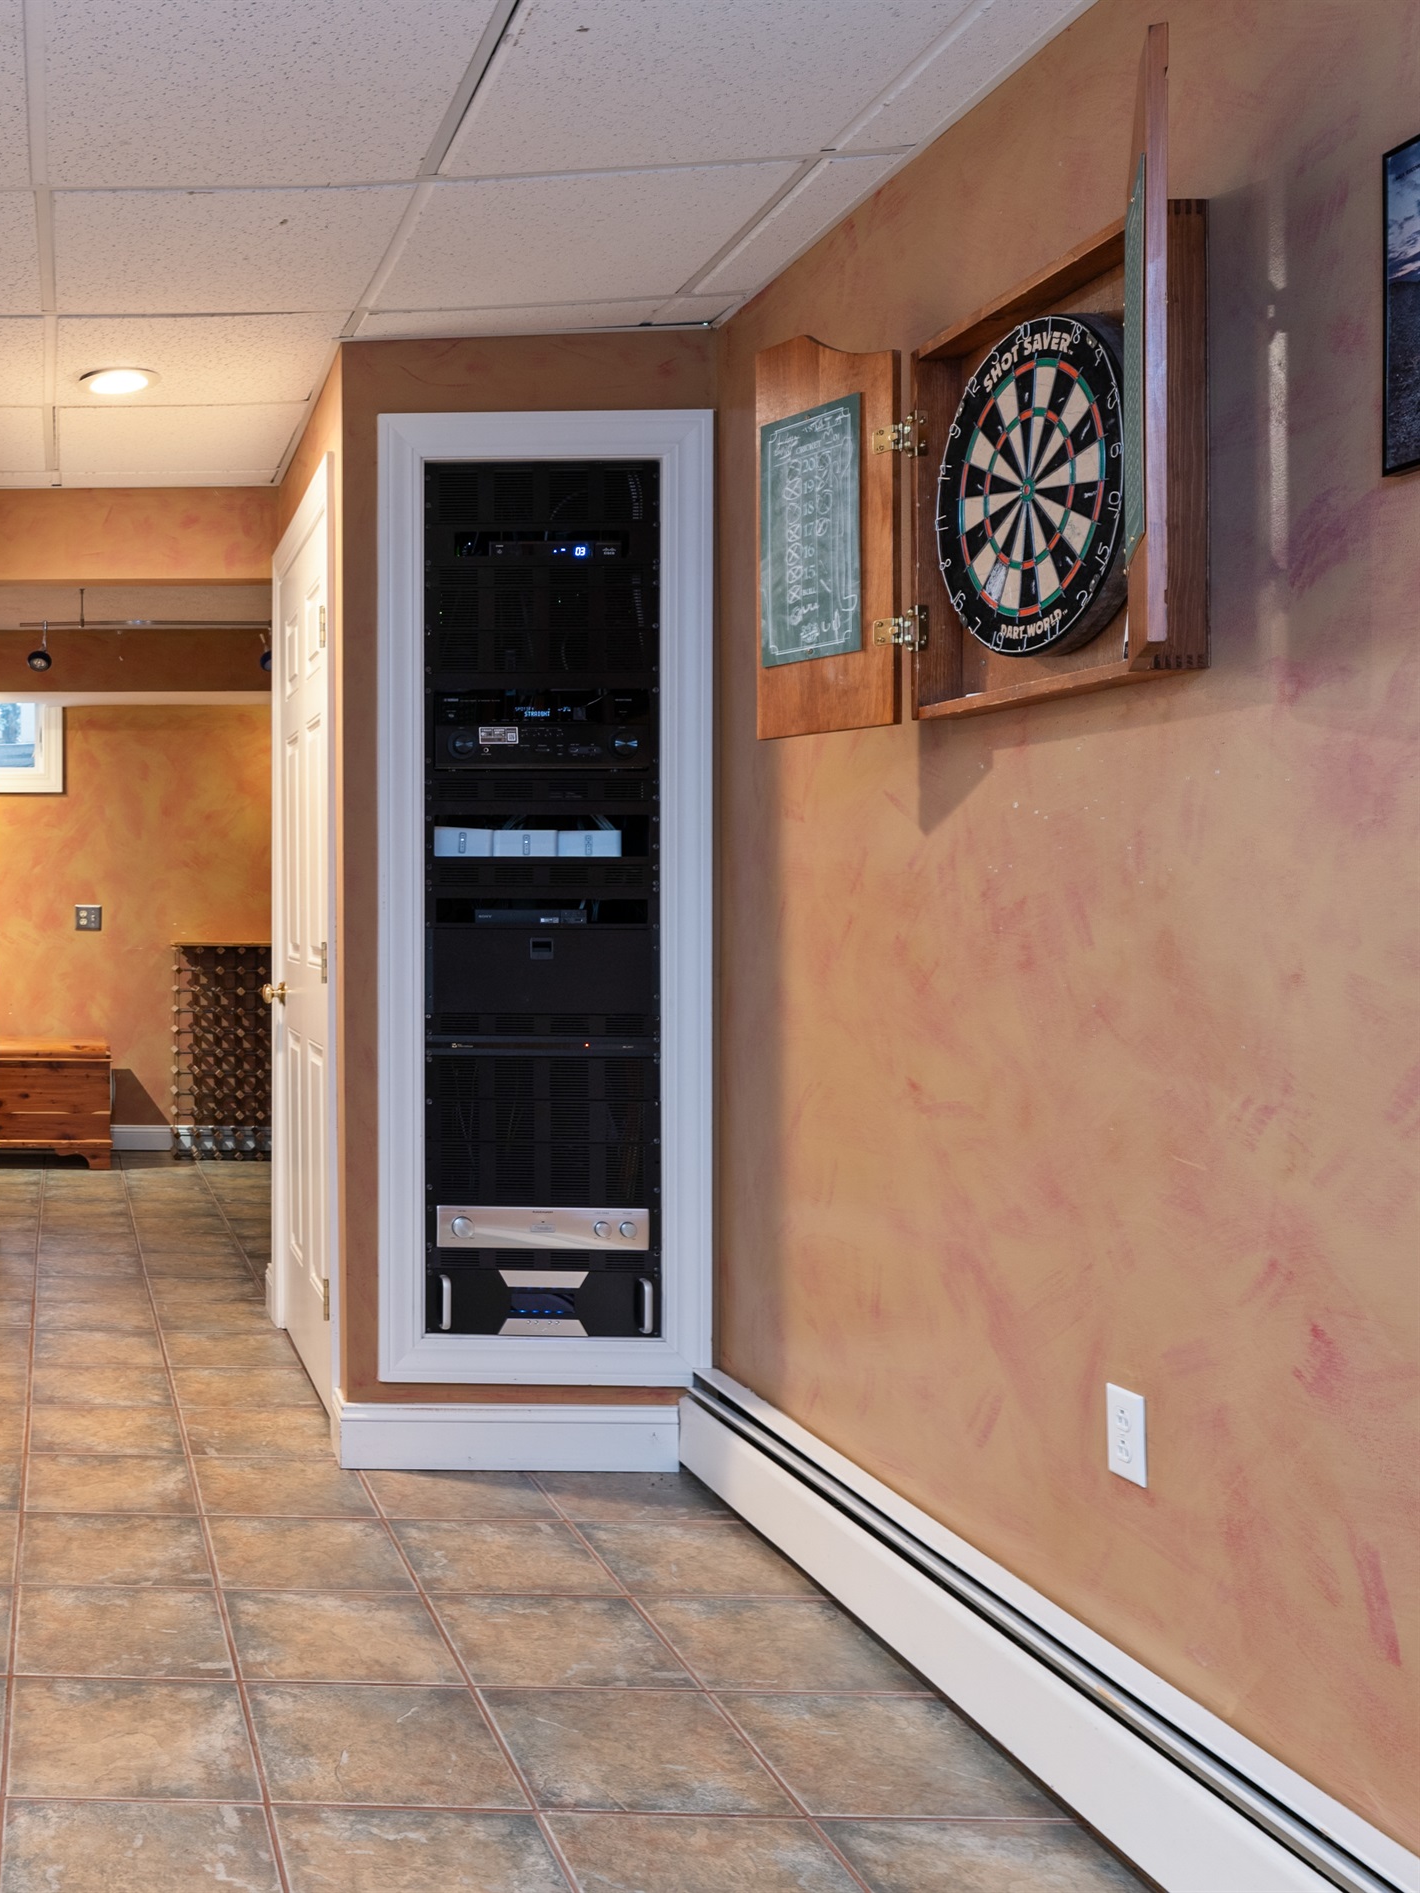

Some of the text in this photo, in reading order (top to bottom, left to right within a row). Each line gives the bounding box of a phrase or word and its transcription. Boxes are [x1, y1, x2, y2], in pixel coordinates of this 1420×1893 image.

[983, 331, 1073, 393] SHOT SAVER
[796, 440, 821, 455] CRICKET
[802, 457, 816, 473] 20
[803, 479, 815, 494] 19
[803, 500, 815, 516] 18
[803, 521, 815, 537] 17
[575, 546, 586, 557] 03
[803, 543, 815, 559] 16
[803, 565, 816, 580] 15
[1000, 608, 1063, 640] DART WORLD
[524, 710, 551, 718] STRAIGHT
